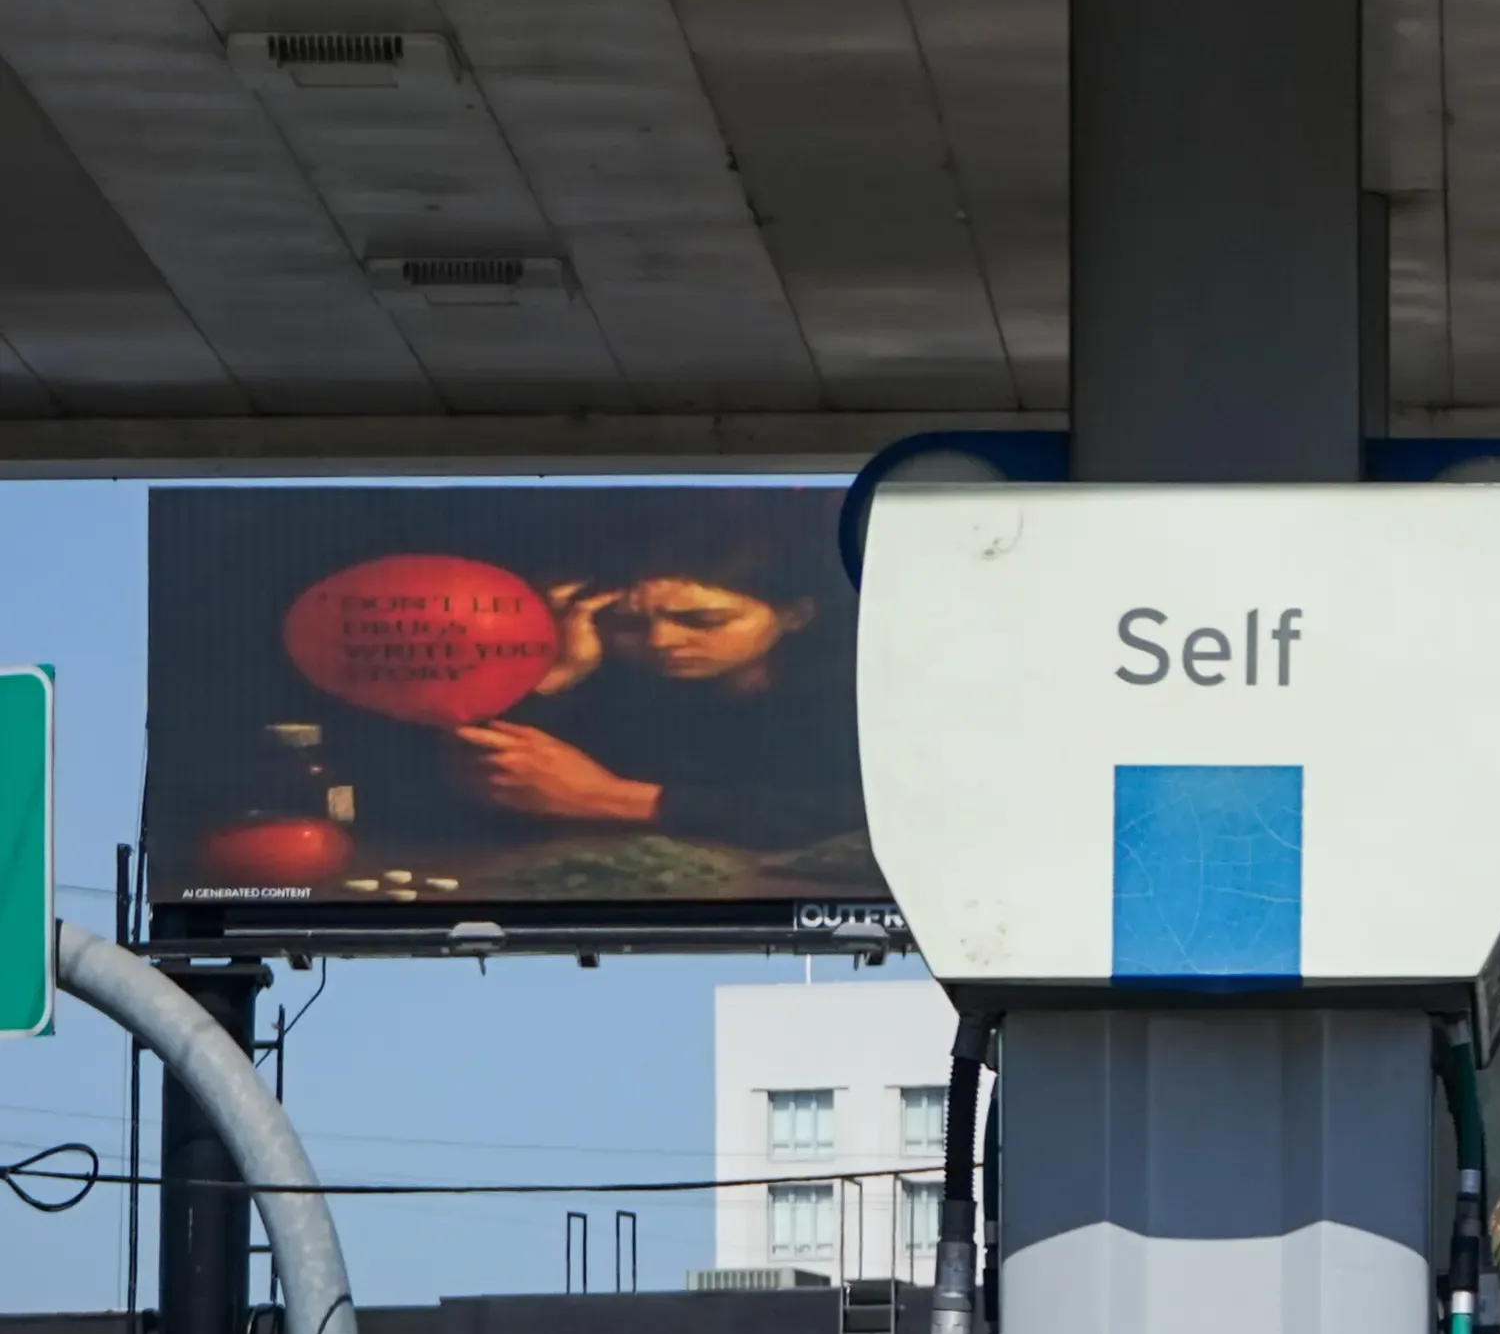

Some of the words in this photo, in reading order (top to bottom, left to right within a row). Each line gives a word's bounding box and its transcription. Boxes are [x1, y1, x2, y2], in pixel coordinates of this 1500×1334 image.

[1114, 606, 1304, 688] Self
[182, 888, 194, 899] AI
[195, 887, 260, 899] GENERATED
[261, 887, 312, 899] CONTENT
